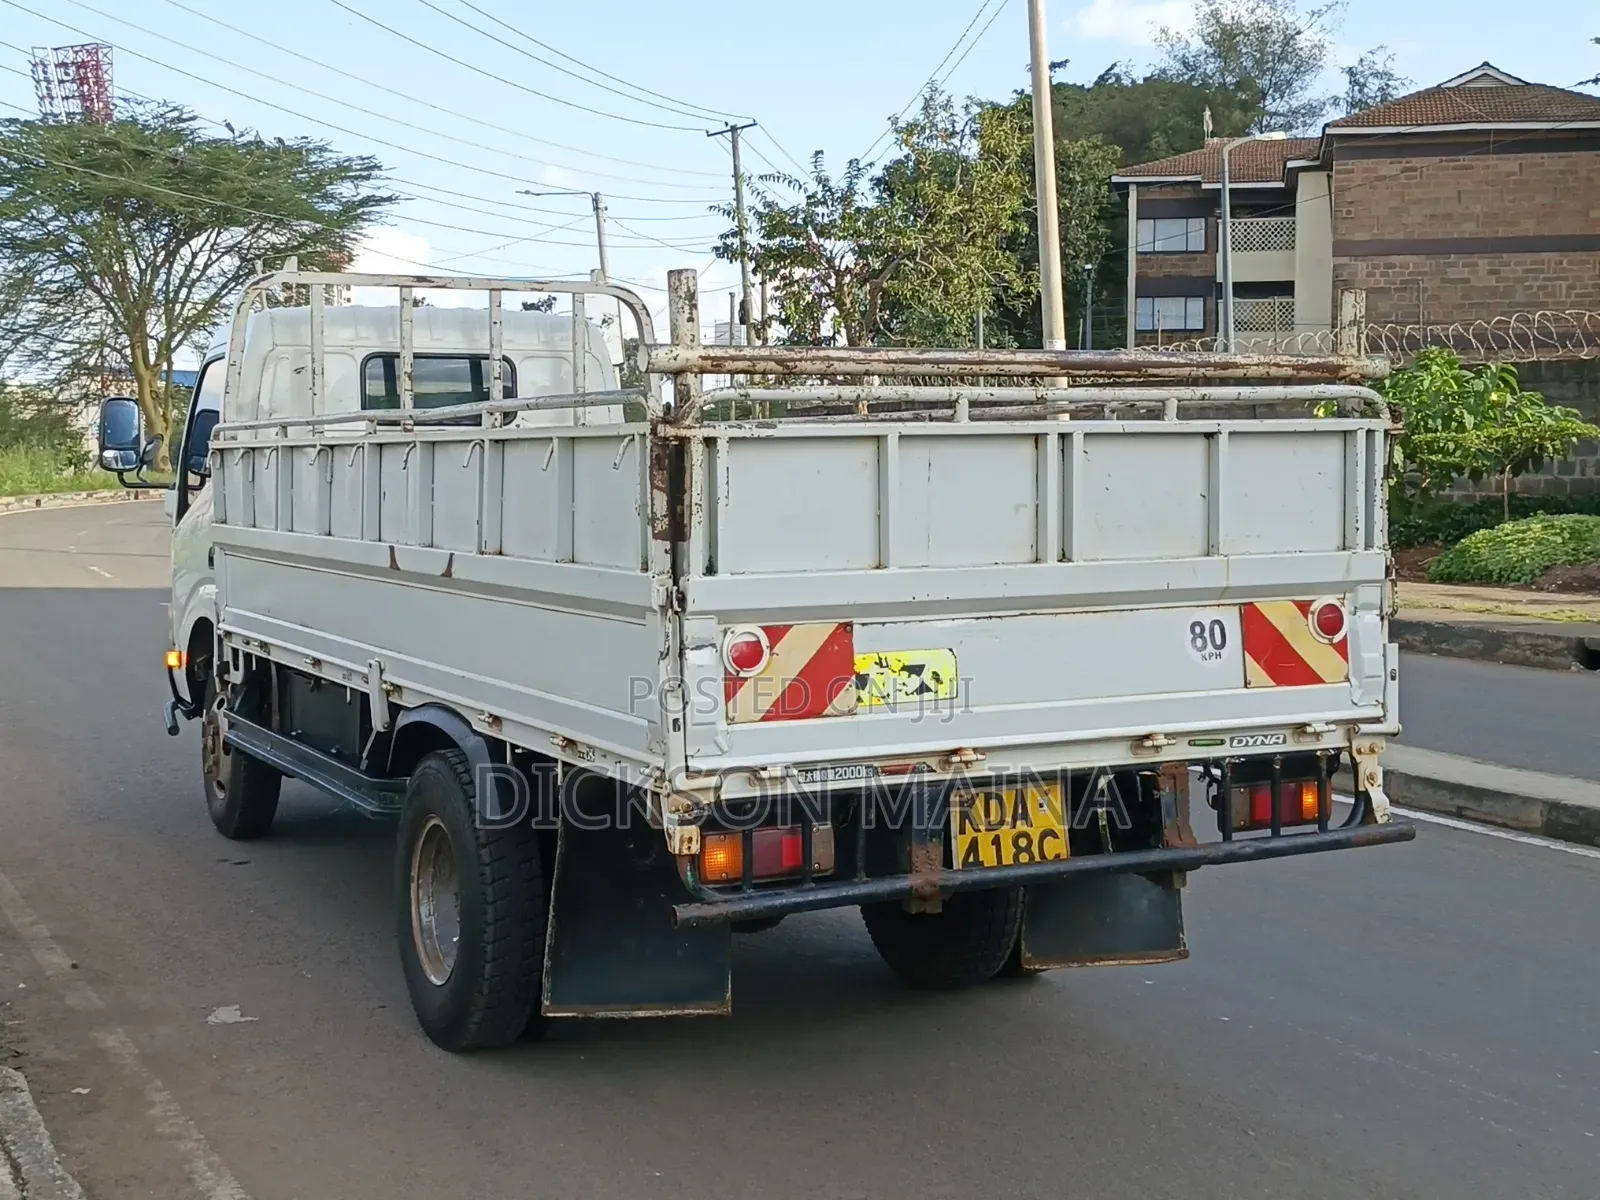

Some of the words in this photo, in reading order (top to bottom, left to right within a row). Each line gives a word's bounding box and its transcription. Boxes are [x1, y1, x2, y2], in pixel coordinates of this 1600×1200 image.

[1189, 619, 1227, 652] 80
[1201, 651, 1222, 662] KPH
[1231, 734, 1286, 748] DYNA
[958, 788, 1034, 835] KDA
[960, 828, 1061, 870] 418C
